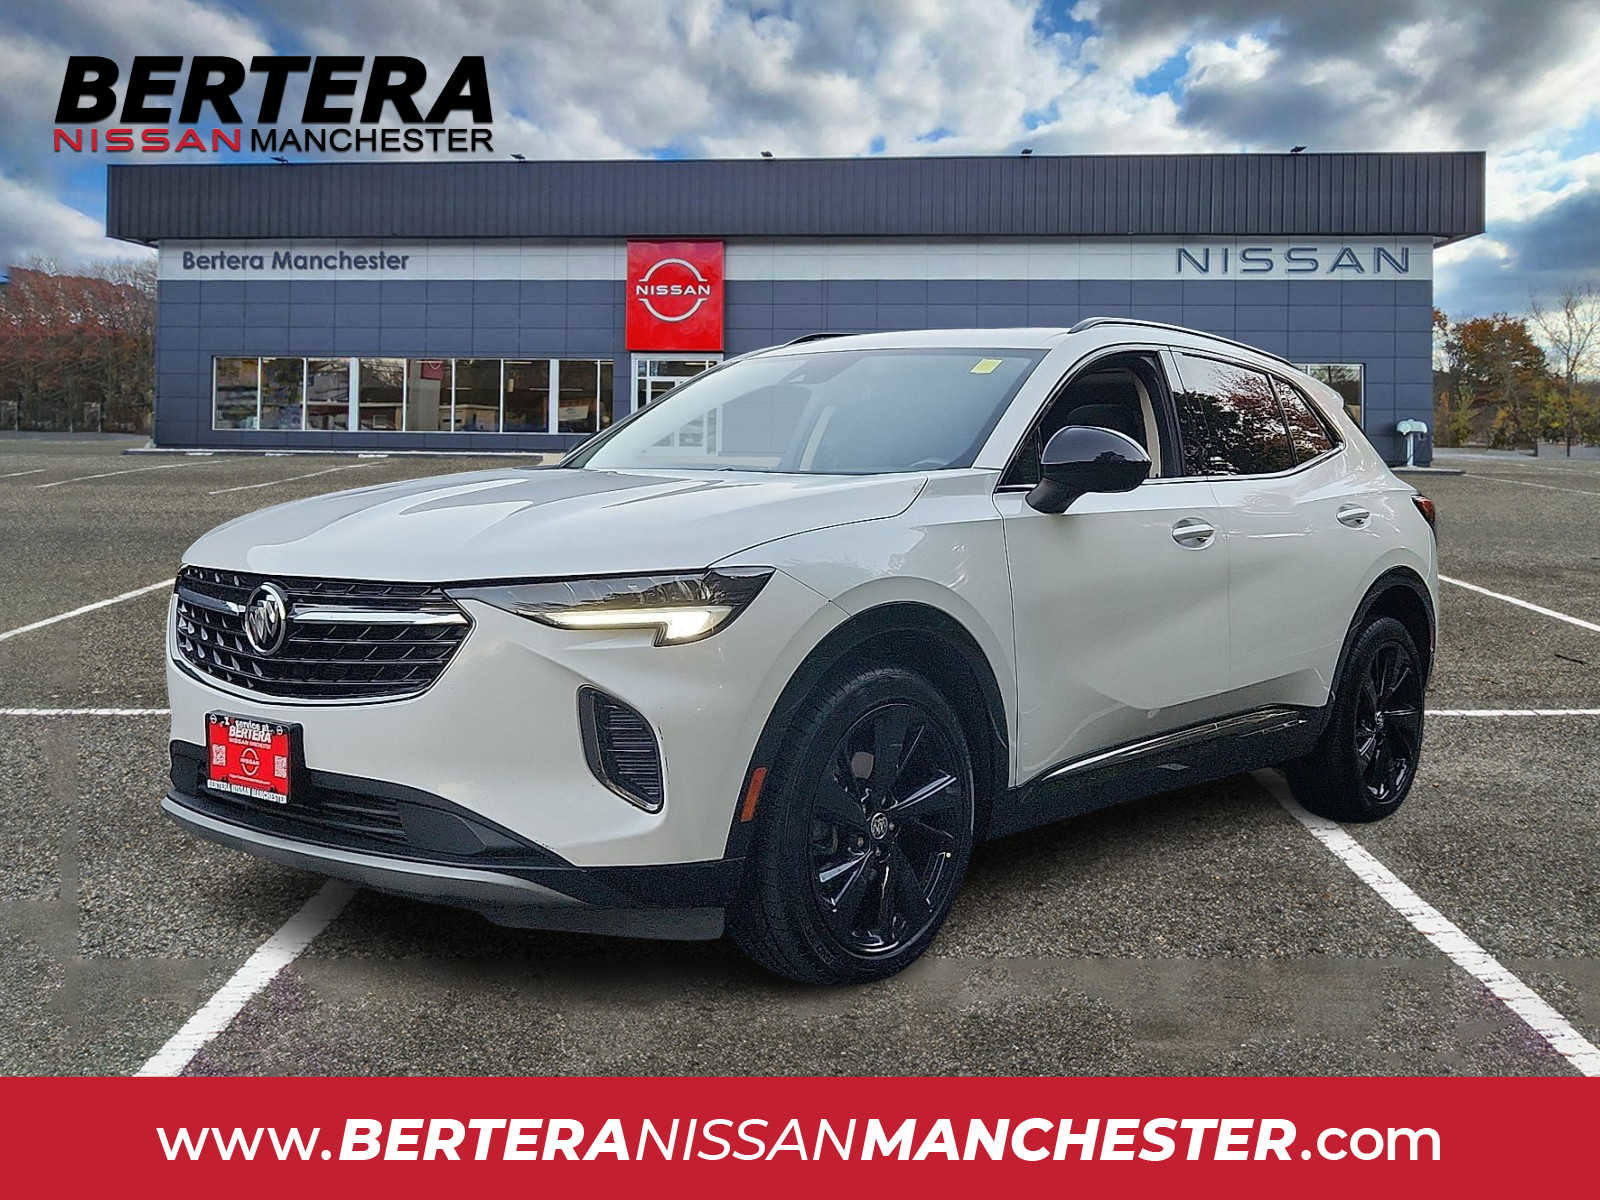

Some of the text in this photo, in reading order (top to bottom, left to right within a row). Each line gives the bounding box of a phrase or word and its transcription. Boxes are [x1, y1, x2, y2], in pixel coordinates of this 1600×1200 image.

[182, 250, 409, 271] Bertera Manchester
[1176, 246, 1410, 274] NISSAN
[635, 283, 711, 297] NISSAN
[229, 725, 271, 743] BERTERA
